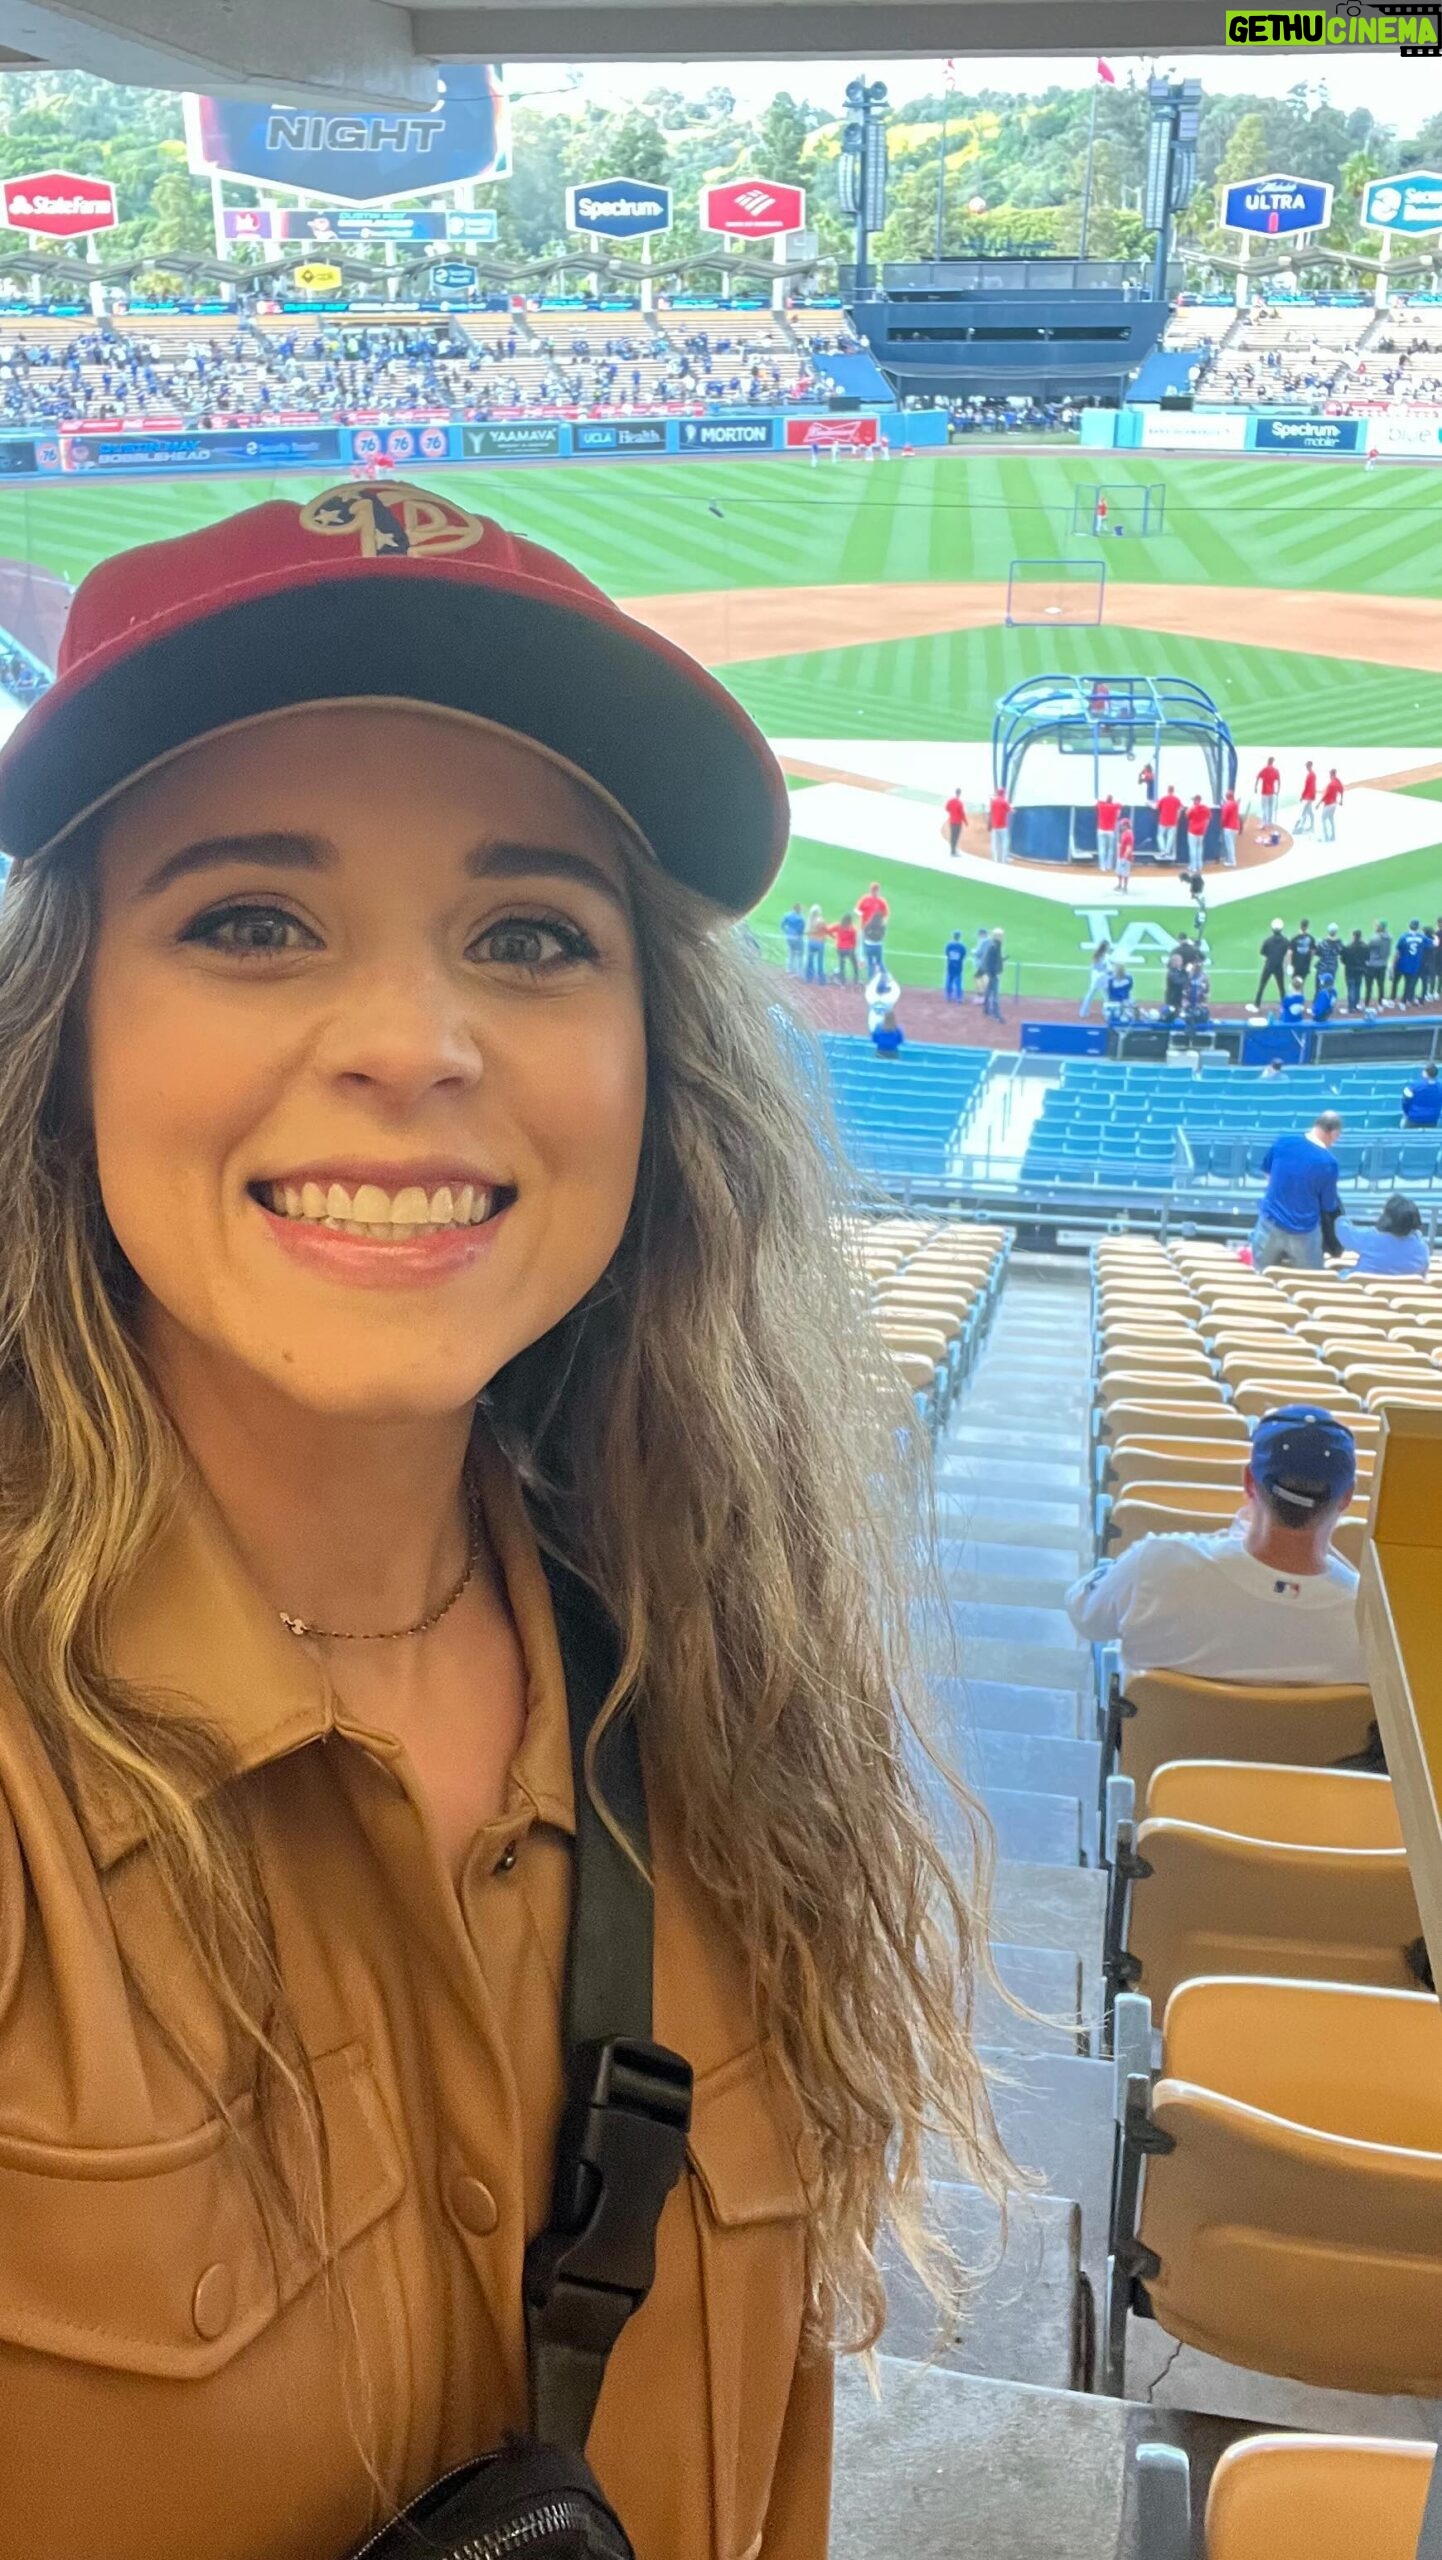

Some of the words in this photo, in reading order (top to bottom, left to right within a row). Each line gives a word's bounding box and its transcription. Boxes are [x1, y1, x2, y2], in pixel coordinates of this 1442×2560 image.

[266, 116, 446, 152] NIGHT
[578, 197, 663, 221] Spectrum
[1245, 193, 1306, 211] ULTRA
[584, 432, 612, 444] UCLA
[618, 429, 660, 444] Health
[701, 426, 766, 442] MORTON
[1271, 421, 1341, 439] Spectrum
[1074, 909, 1211, 964] LA
